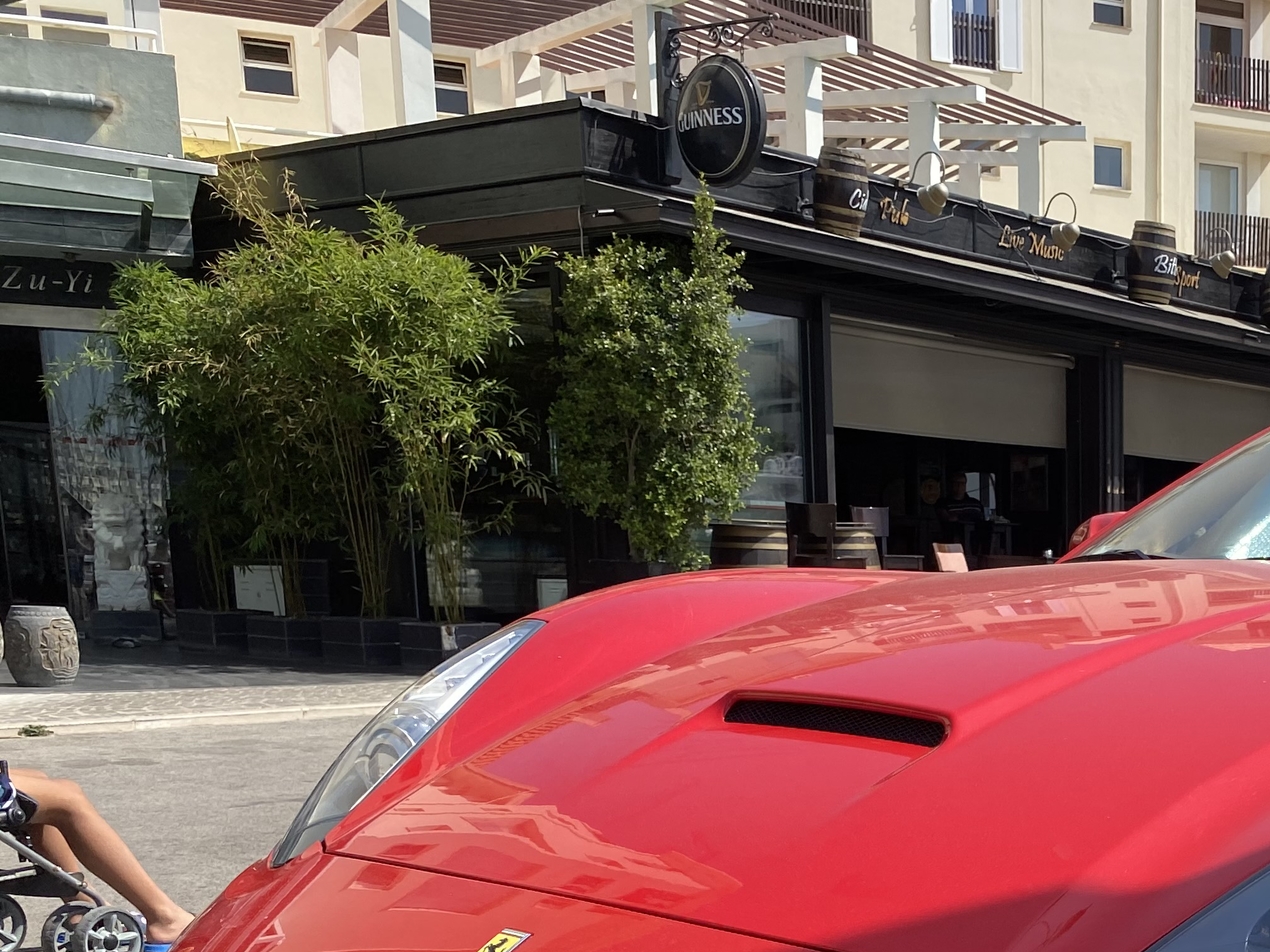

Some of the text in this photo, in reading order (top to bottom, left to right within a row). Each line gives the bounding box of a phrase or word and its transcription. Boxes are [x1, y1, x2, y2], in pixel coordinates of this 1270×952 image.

[678, 107, 743, 132] GUINNESS
[880, 197, 909, 226] Pub
[999, 225, 1064, 261] Live Music
[1, 265, 93, 293] Zu-Yi
[1174, 266, 1201, 297] Sport
